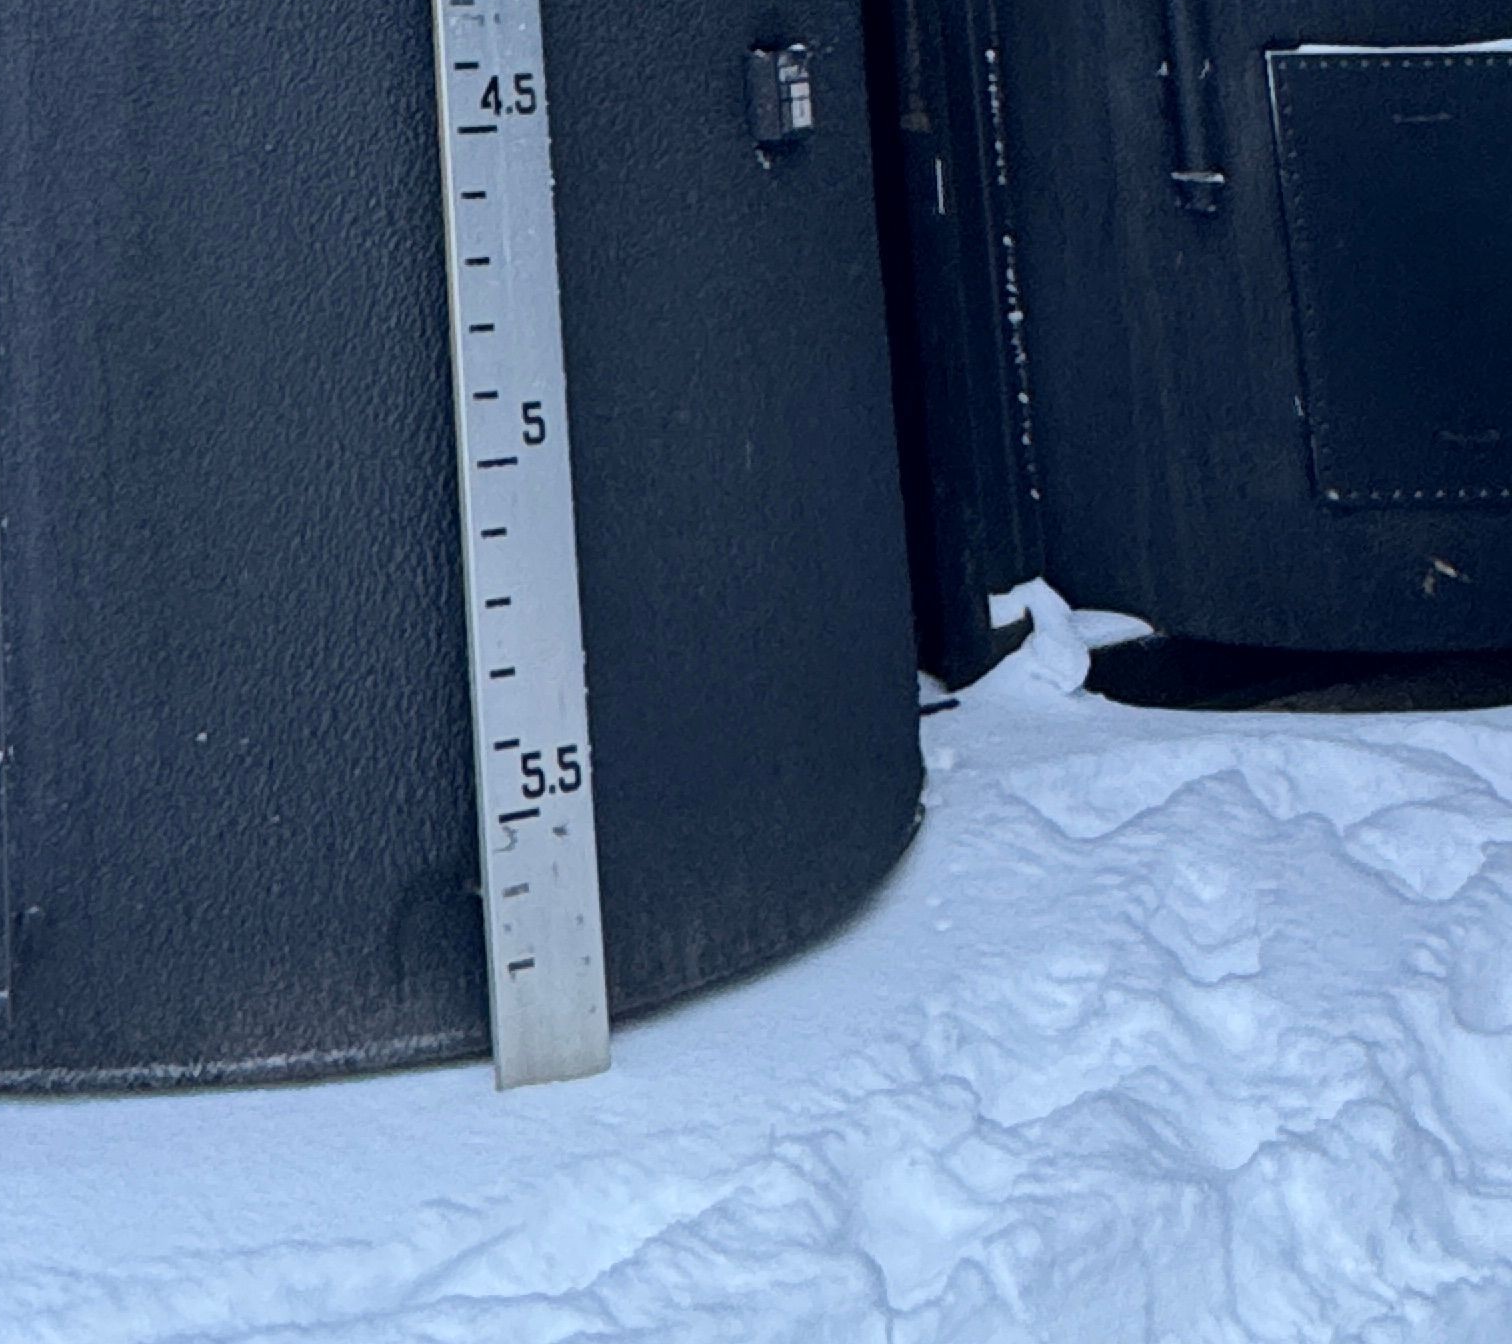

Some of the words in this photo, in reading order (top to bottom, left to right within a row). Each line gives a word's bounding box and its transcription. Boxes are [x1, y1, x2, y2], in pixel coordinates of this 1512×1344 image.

[481, 72, 536, 115] 4.5
[522, 401, 545, 444] 5
[521, 743, 582, 798] 5.5
